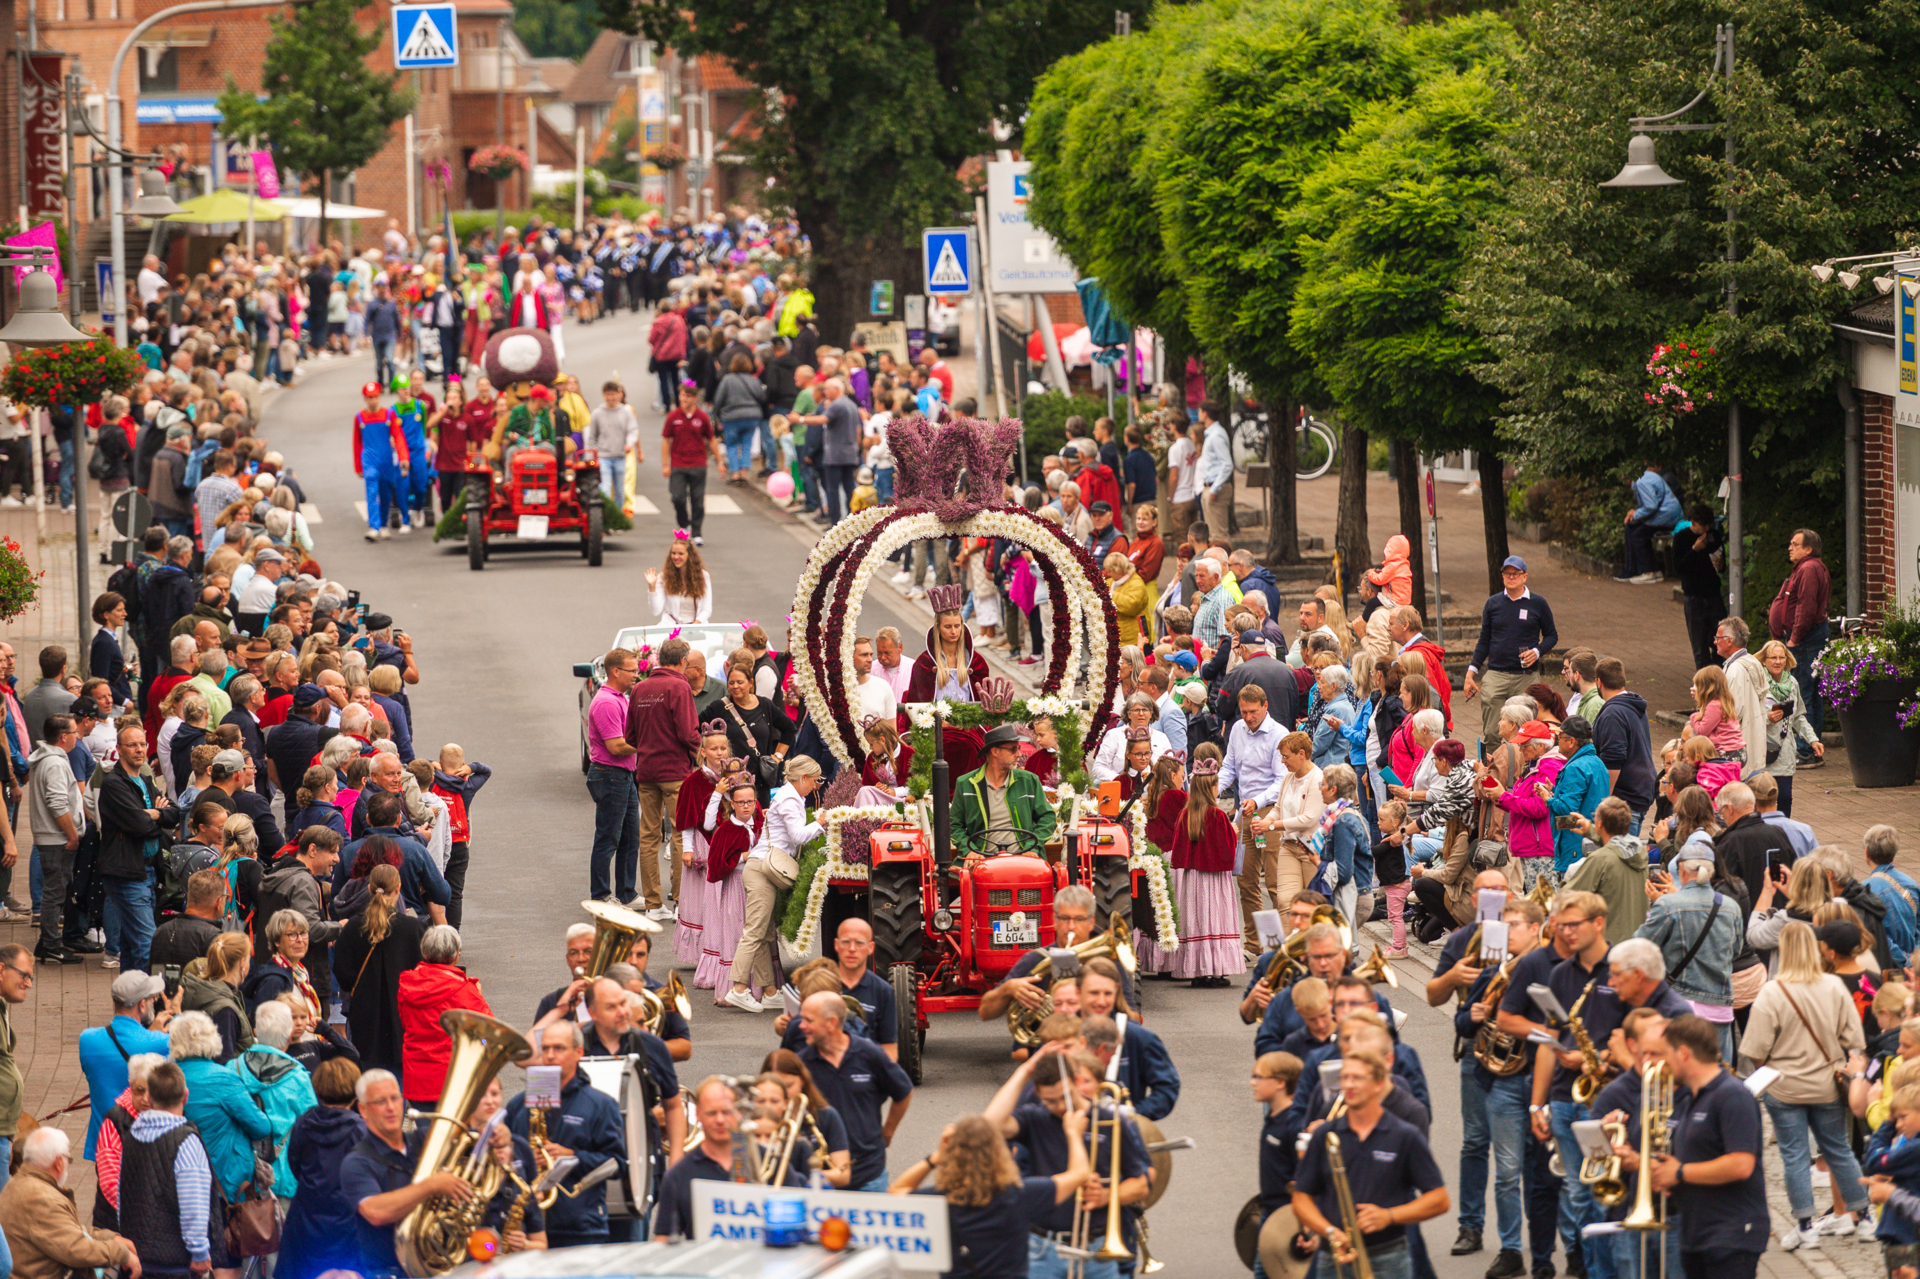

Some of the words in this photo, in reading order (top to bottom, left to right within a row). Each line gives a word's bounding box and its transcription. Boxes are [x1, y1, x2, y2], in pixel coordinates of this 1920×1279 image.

[34, 80, 63, 218] lzhäcker
[1902, 367, 1916, 383] EDEKA
[996, 933, 1003, 943] E
[1005, 932, 1025, 942] 604
[712, 1197, 925, 1228] BLACHESTER
